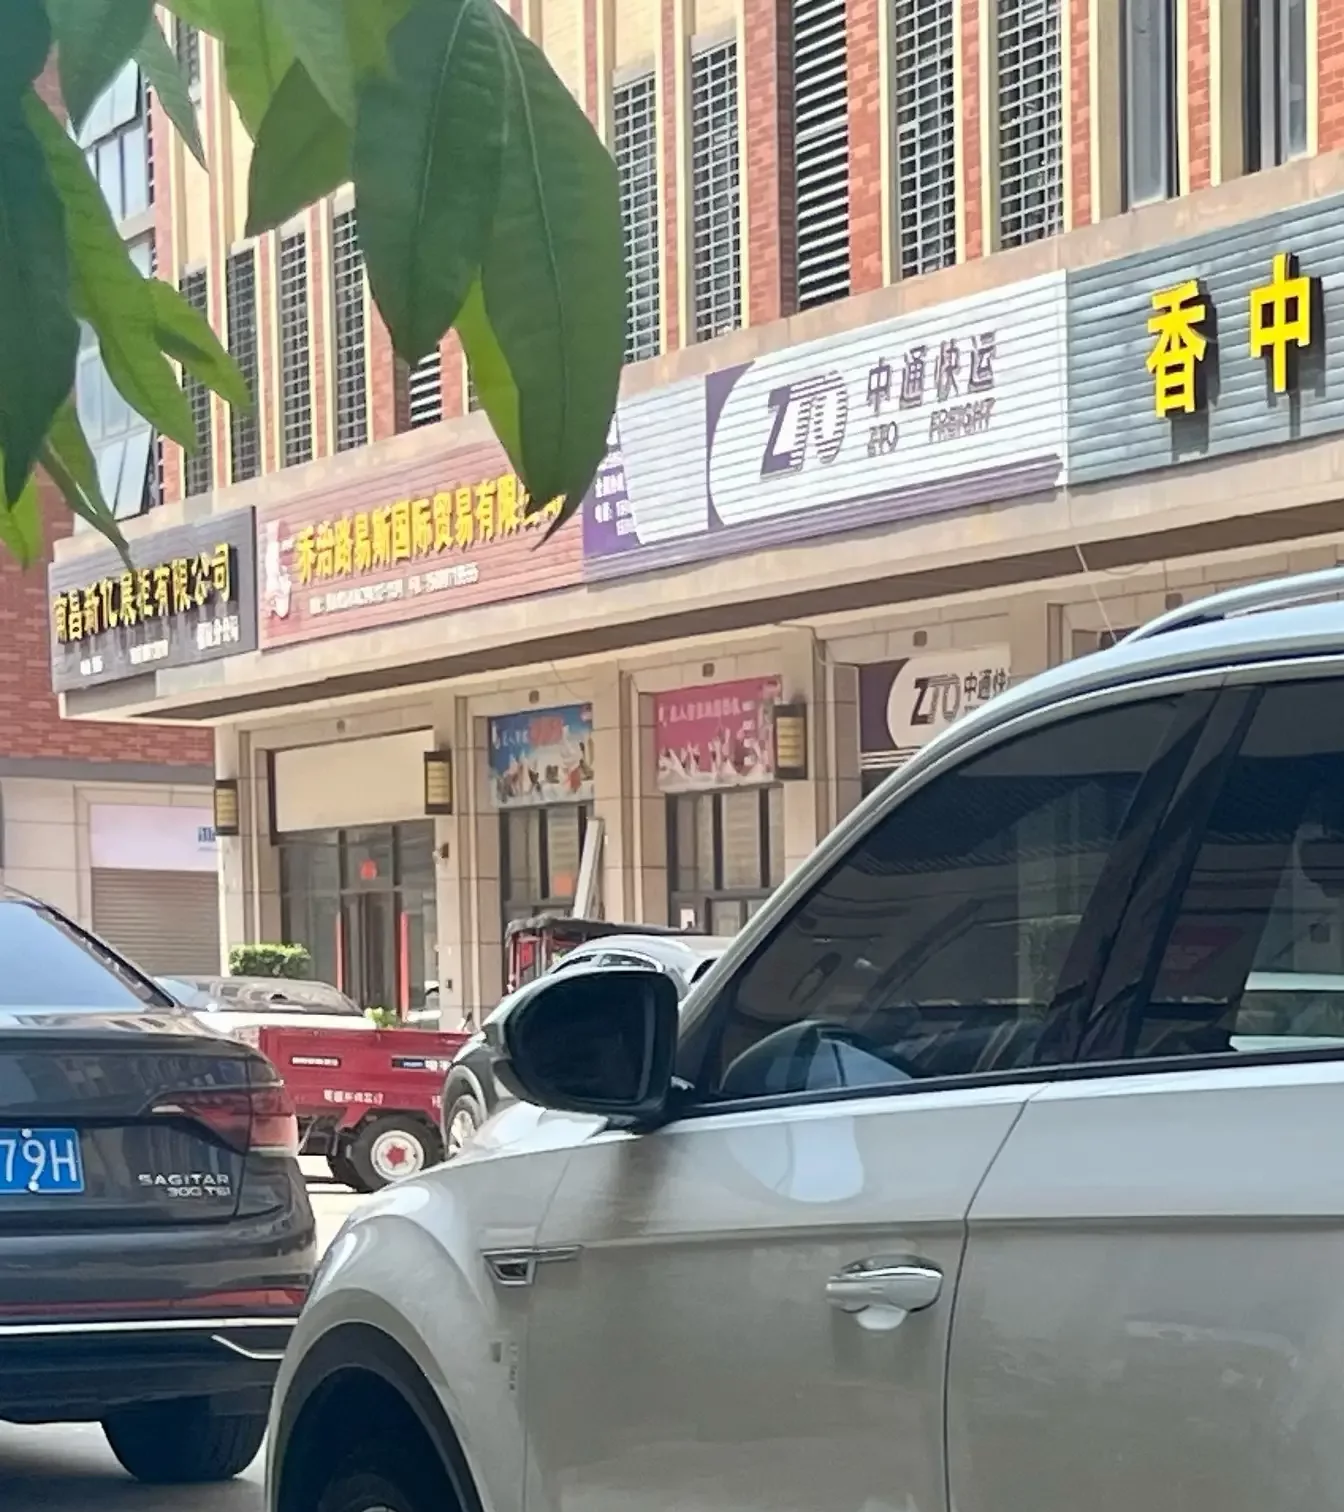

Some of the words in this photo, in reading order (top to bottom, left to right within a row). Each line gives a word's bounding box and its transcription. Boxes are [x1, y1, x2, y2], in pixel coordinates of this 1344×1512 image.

[866, 331, 997, 417] 中通快运
[963, 667, 1010, 702] 中通快
[0, 1138, 78, 1183] 79H
[138, 1173, 230, 1187] SAGITAR
